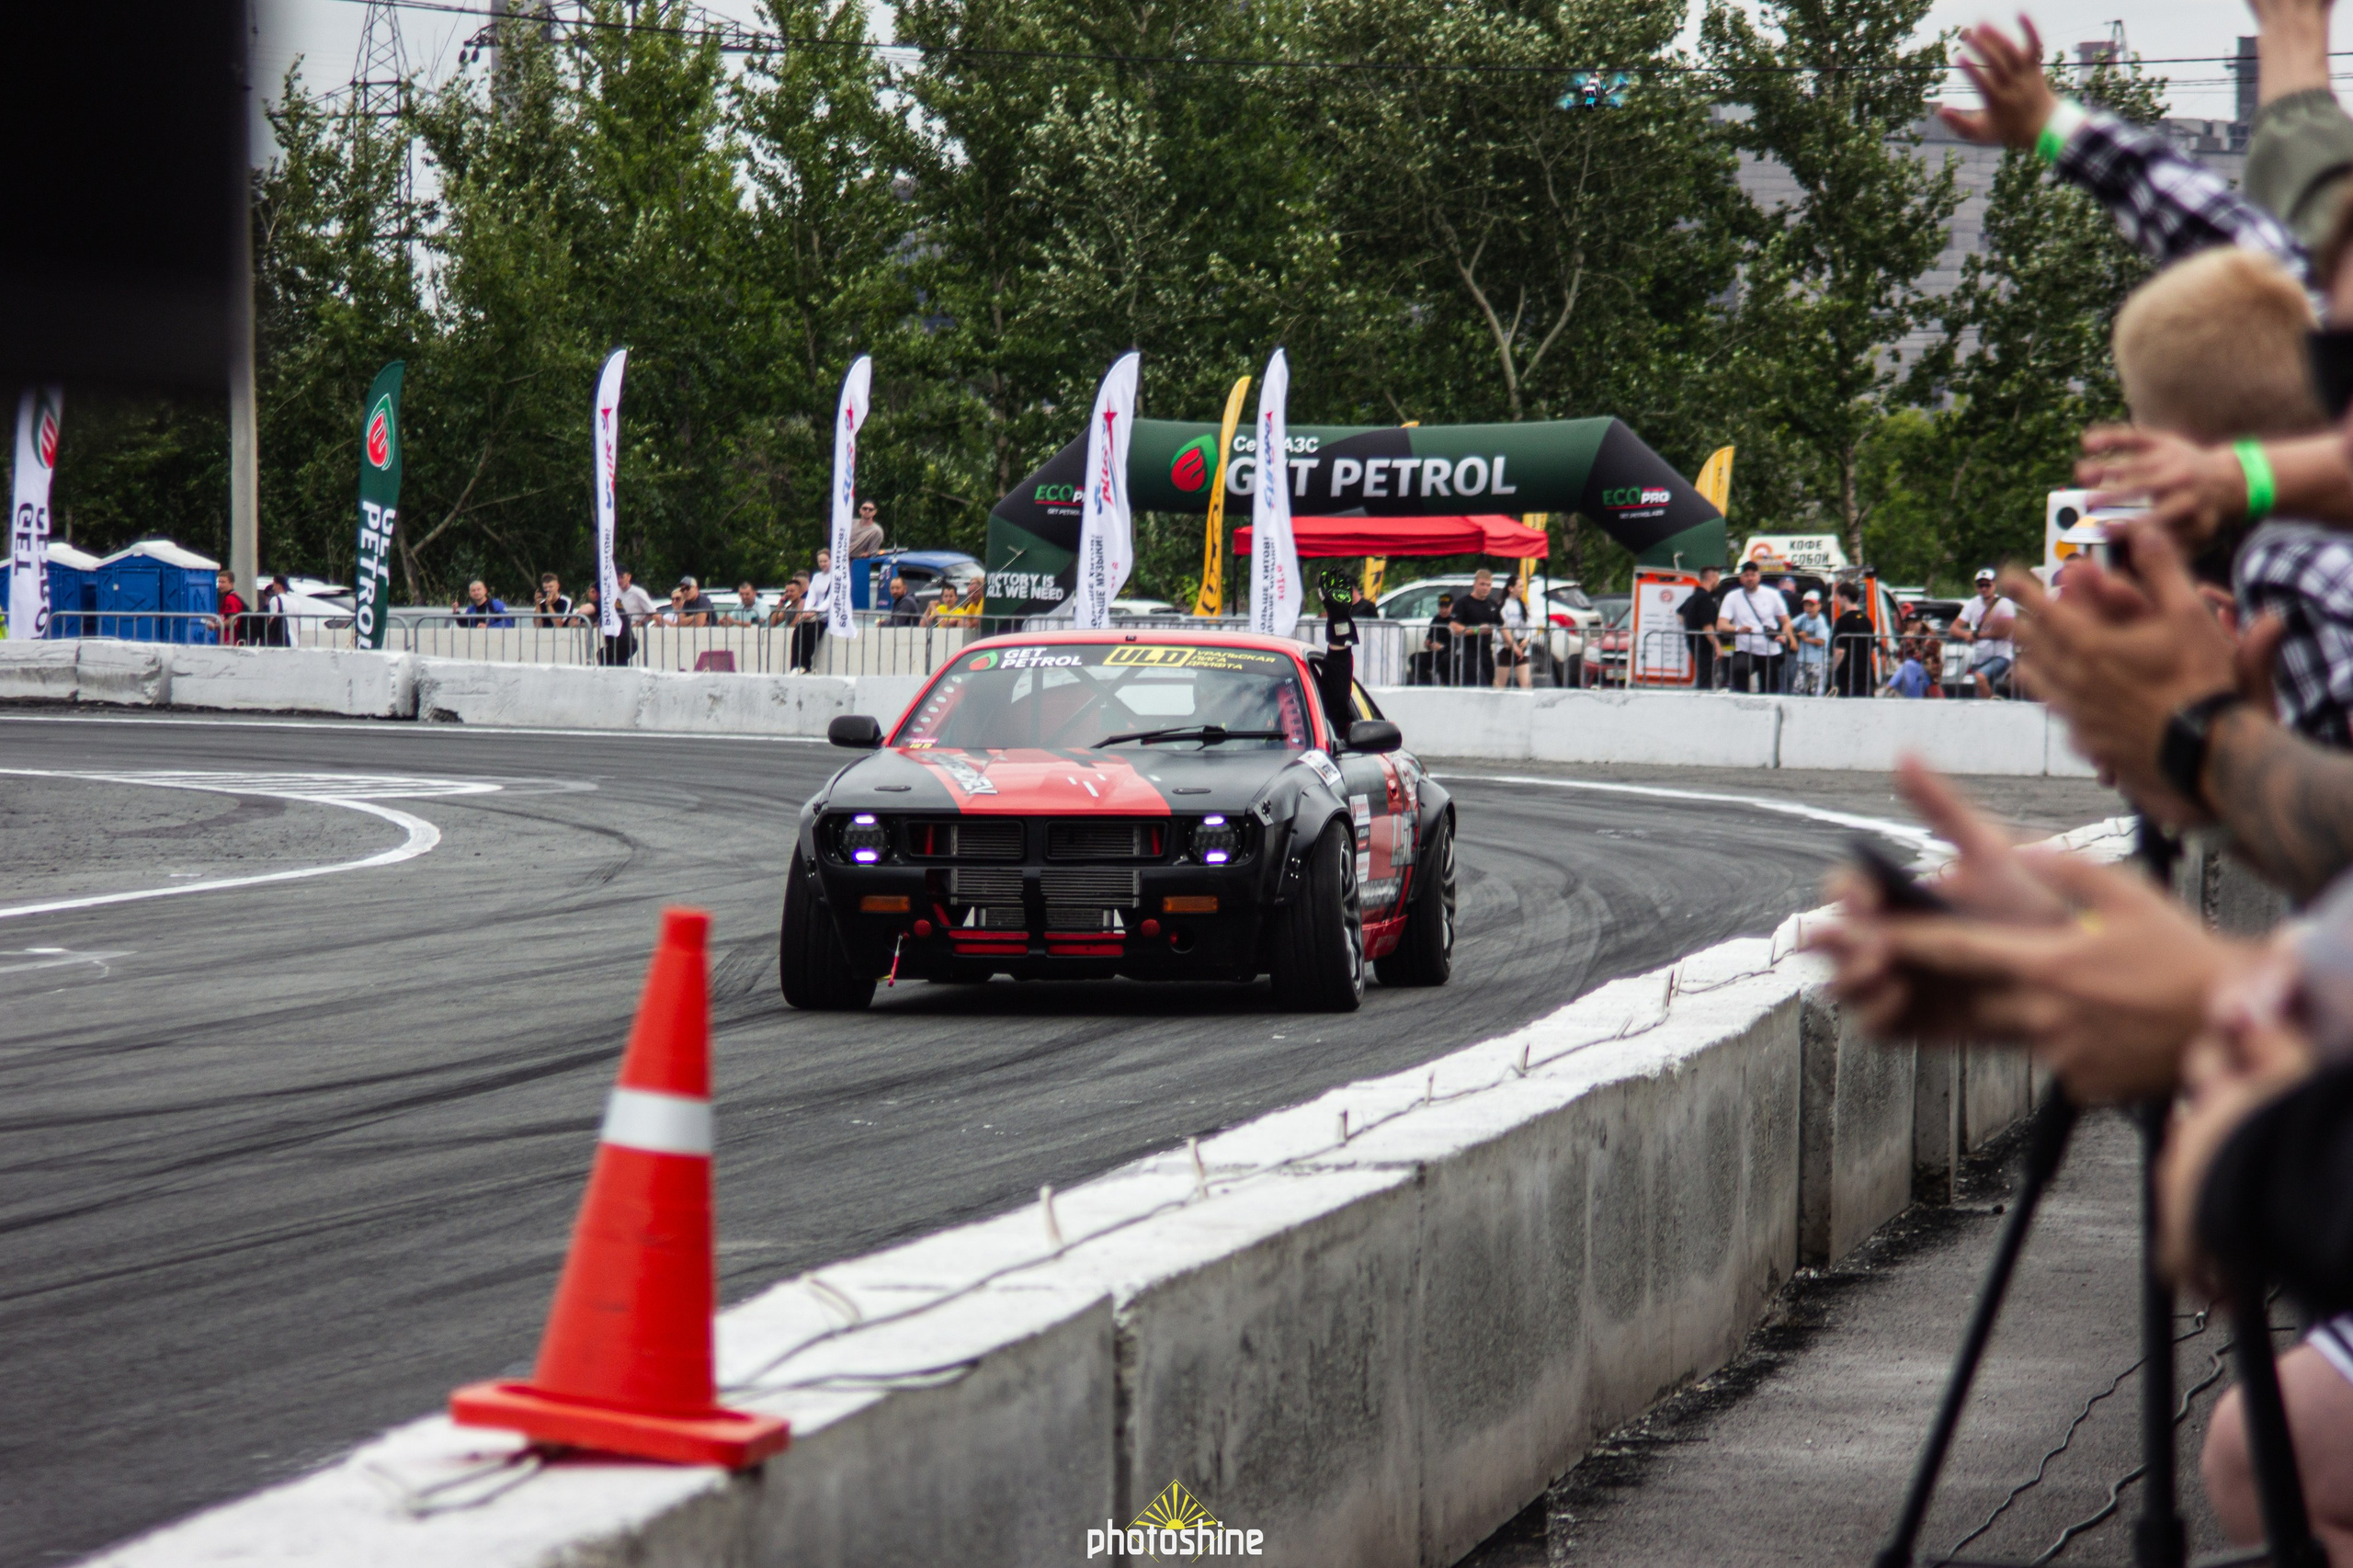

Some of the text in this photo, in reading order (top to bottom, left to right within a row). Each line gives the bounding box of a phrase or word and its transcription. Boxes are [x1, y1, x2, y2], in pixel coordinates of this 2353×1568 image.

[1233, 436, 1257, 452] Се
[1225, 455, 1518, 497] GT PETROL
[1790, 540, 1823, 550] КОФЕ
[358, 500, 381, 650] PETROL
[986, 573, 1055, 588] VICTORY IS
[986, 585, 1065, 601] ALL WE NEED
[1259, 587, 1269, 634] ОЛЬШЕ
[1004, 646, 1048, 659] GET
[1000, 655, 1083, 669] PETROL
